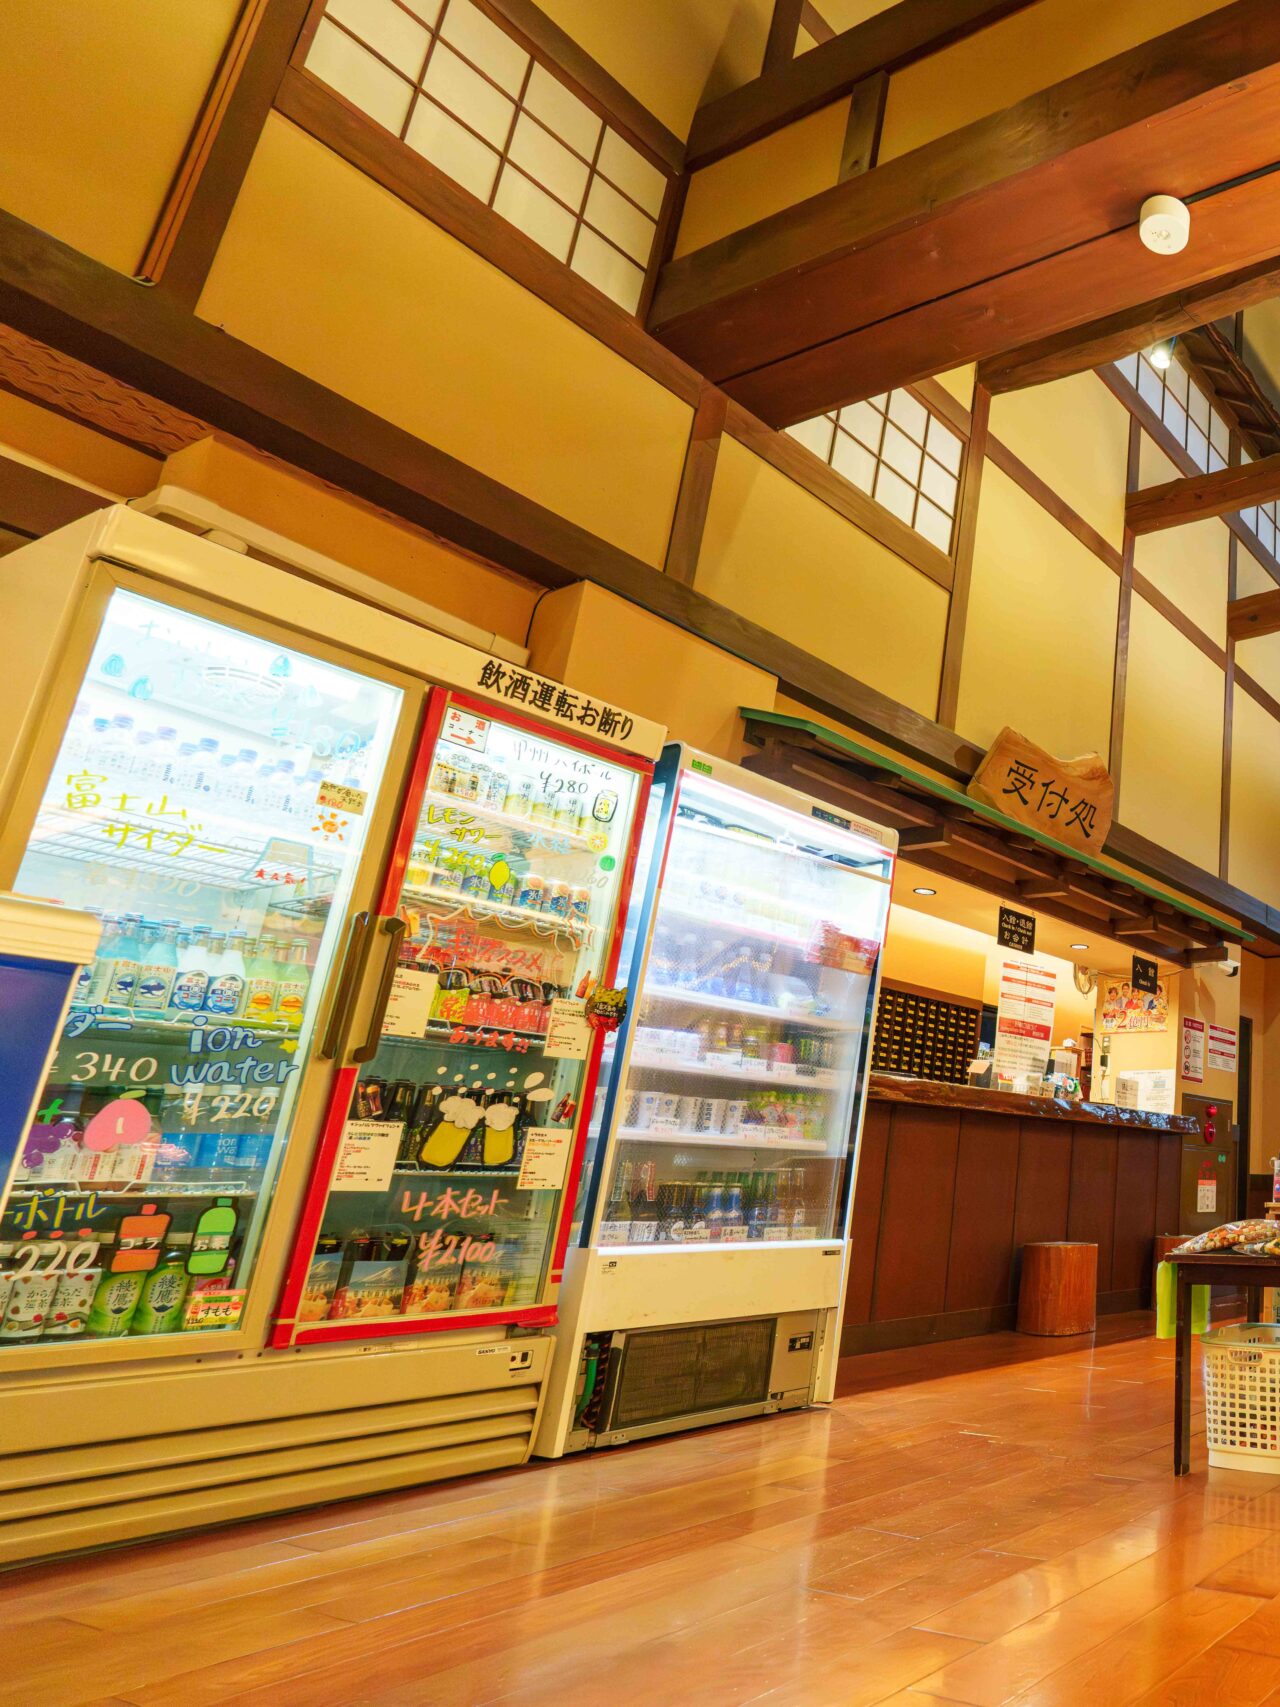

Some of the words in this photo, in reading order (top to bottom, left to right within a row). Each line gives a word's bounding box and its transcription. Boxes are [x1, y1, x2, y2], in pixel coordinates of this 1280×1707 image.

[477, 659, 635, 741] 飲酒運転お断り
[450, 711, 487, 732] お酒
[66, 769, 188, 821] 富士山
[540, 769, 589, 794] ¥280
[1002, 760, 1097, 838] 受付処
[427, 805, 476, 825] レモン
[102, 823, 231, 857] サイダー
[450, 827, 503, 844] サワー
[188, 1015, 263, 1054] ion
[171, 1056, 300, 1086] water
[180, 1091, 276, 1125] ¥220
[4, 1188, 109, 1230] ボトル
[401, 1186, 509, 1222] 4本セット
[120, 1237, 161, 1251] コーラ
[194, 1237, 228, 1251] お茶
[0, 1240, 99, 1281] 220
[114, 1279, 134, 1307] 綾鷹
[154, 1273, 176, 1304] 綾鷹
[201, 1304, 233, 1318] すもも
